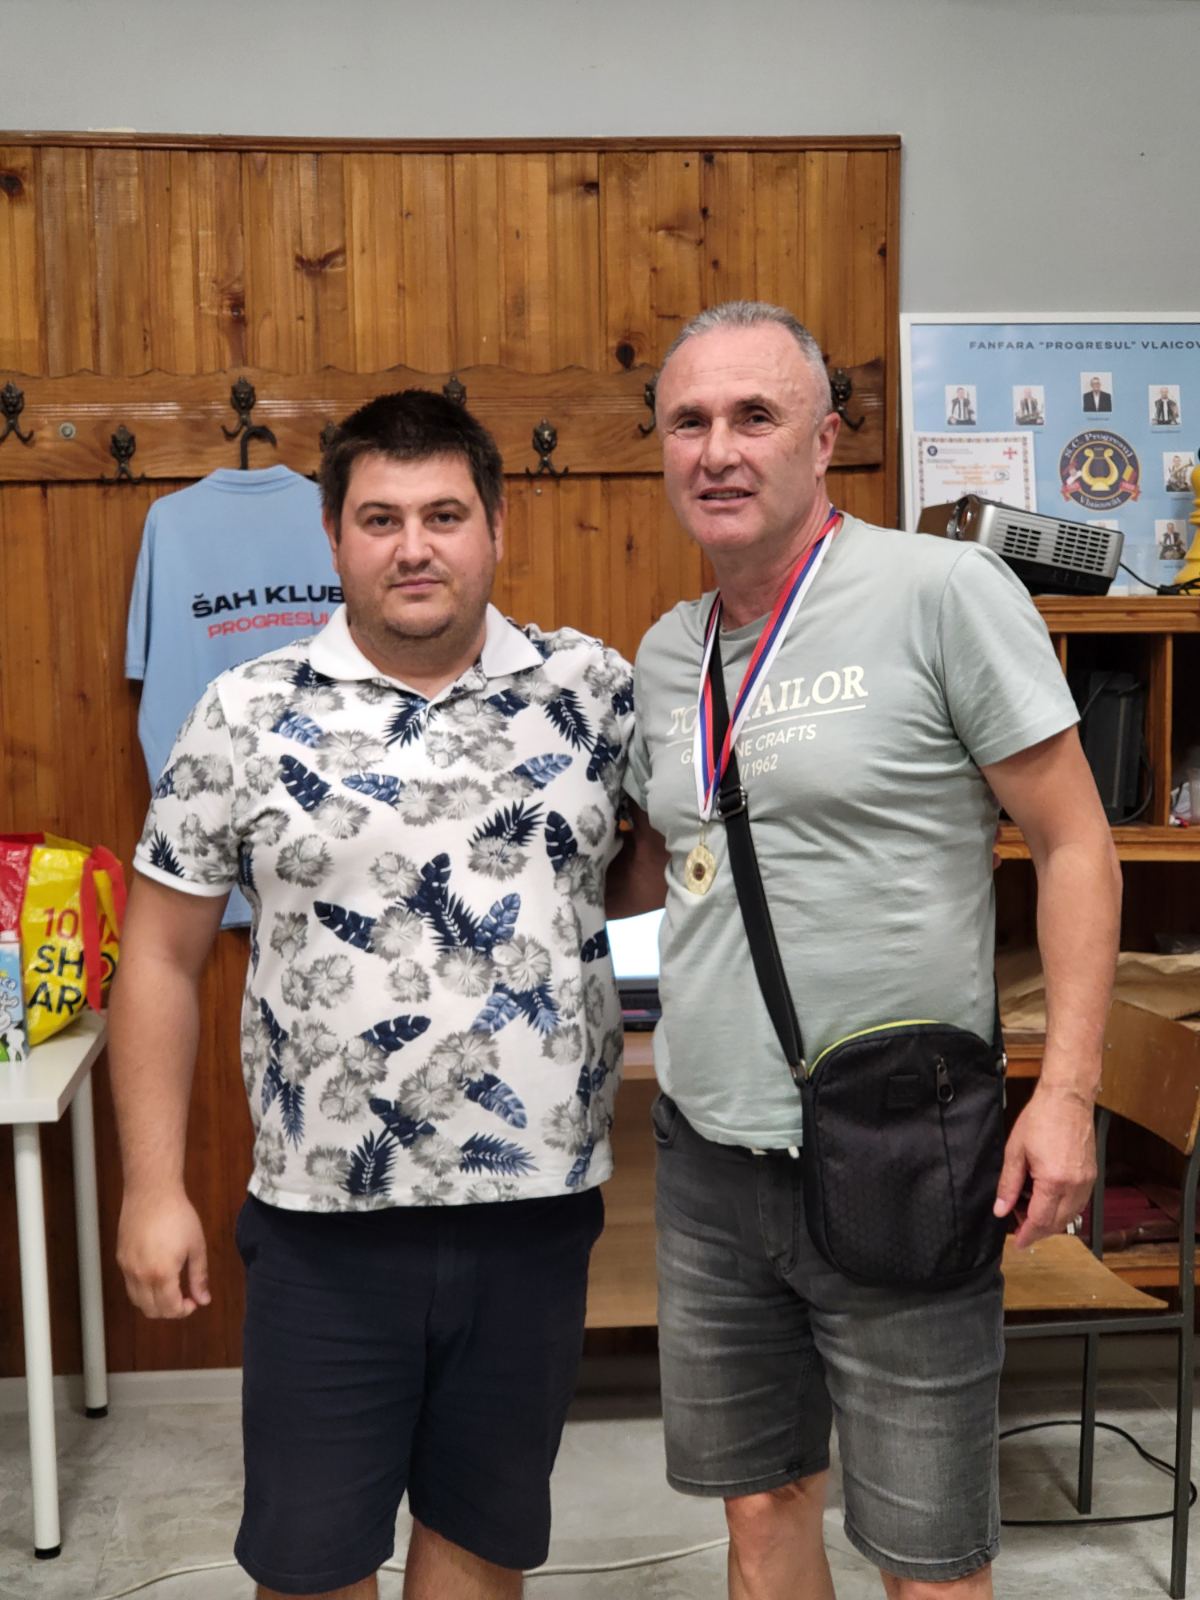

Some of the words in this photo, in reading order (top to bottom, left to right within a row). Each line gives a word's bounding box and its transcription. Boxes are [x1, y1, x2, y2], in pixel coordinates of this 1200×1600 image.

[969, 341, 1034, 350] FANFARA
[1039, 341, 1137, 350] "PROGRESUL"
[191, 588, 257, 618] ŠAH
[265, 584, 345, 604] KLUB
[744, 665, 868, 719] AILOR
[755, 724, 817, 751] CRAFTS
[751, 754, 779, 777] 1962
[43, 907, 79, 940] 10
